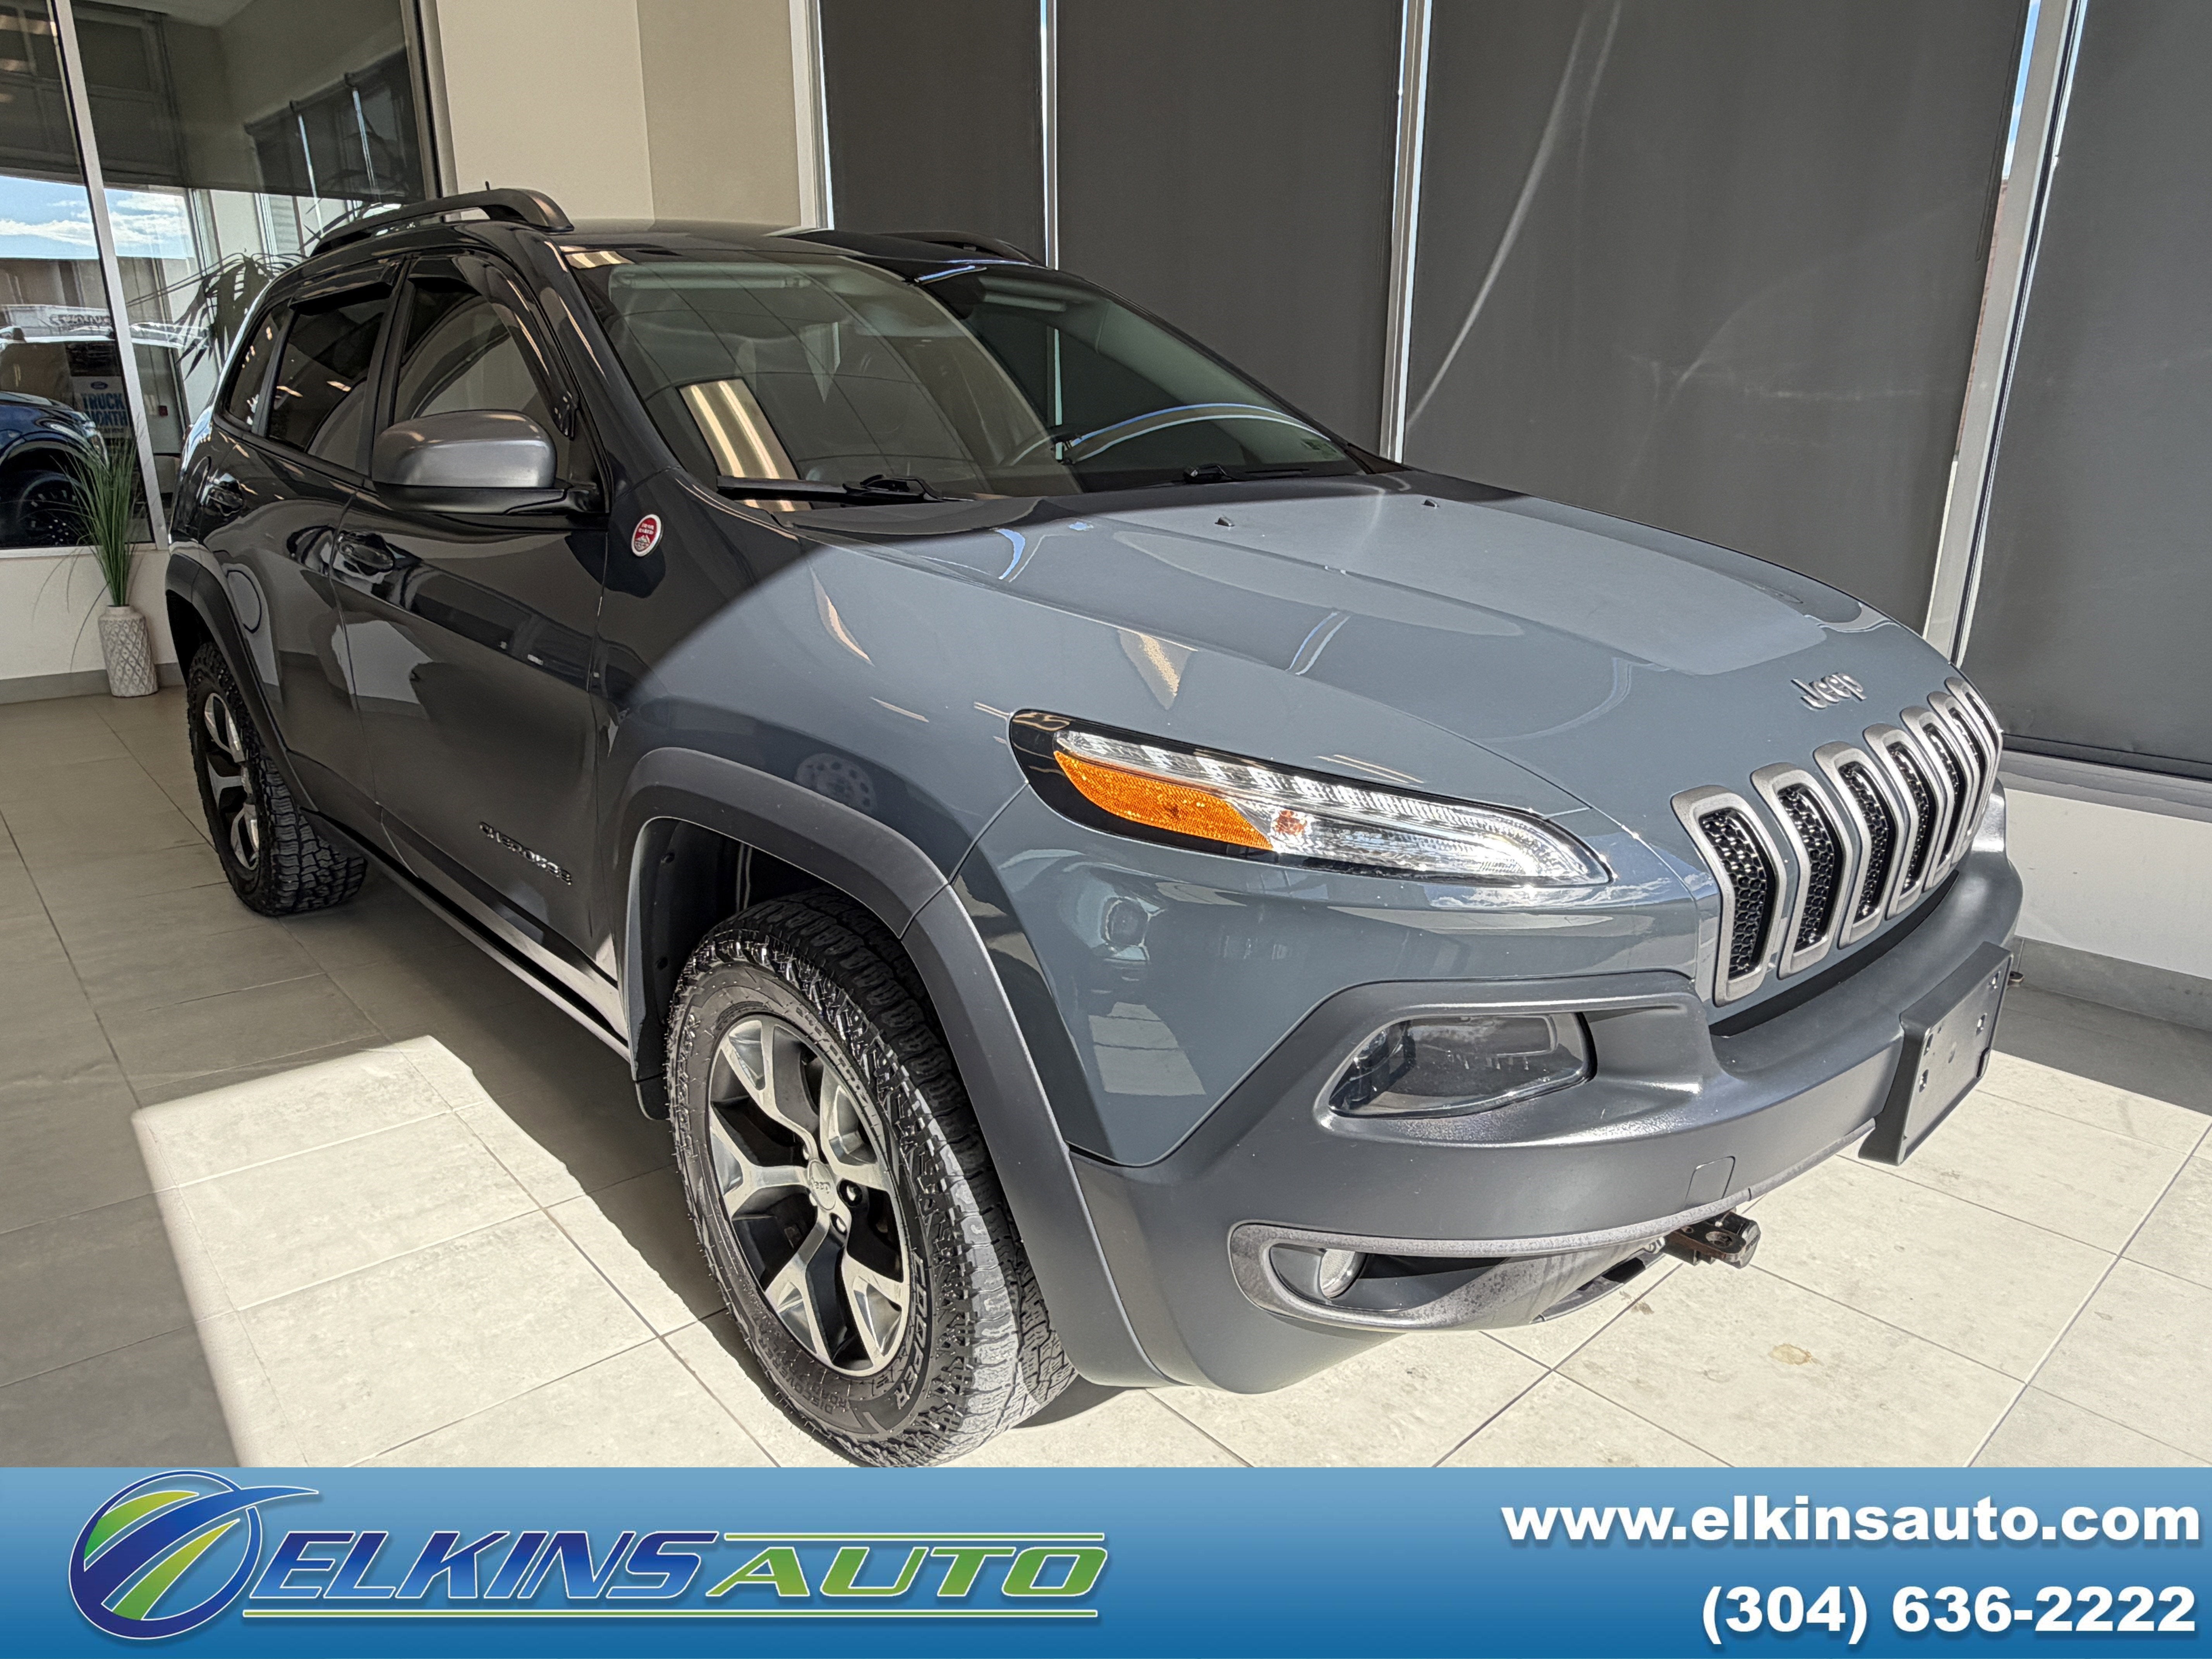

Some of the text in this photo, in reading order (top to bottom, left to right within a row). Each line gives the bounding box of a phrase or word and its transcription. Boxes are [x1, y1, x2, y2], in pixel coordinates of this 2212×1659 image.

[81, 393, 125, 410] TRUCK
[1791, 672, 1867, 709] Jeep
[894, 1251, 928, 1410] COOPER
